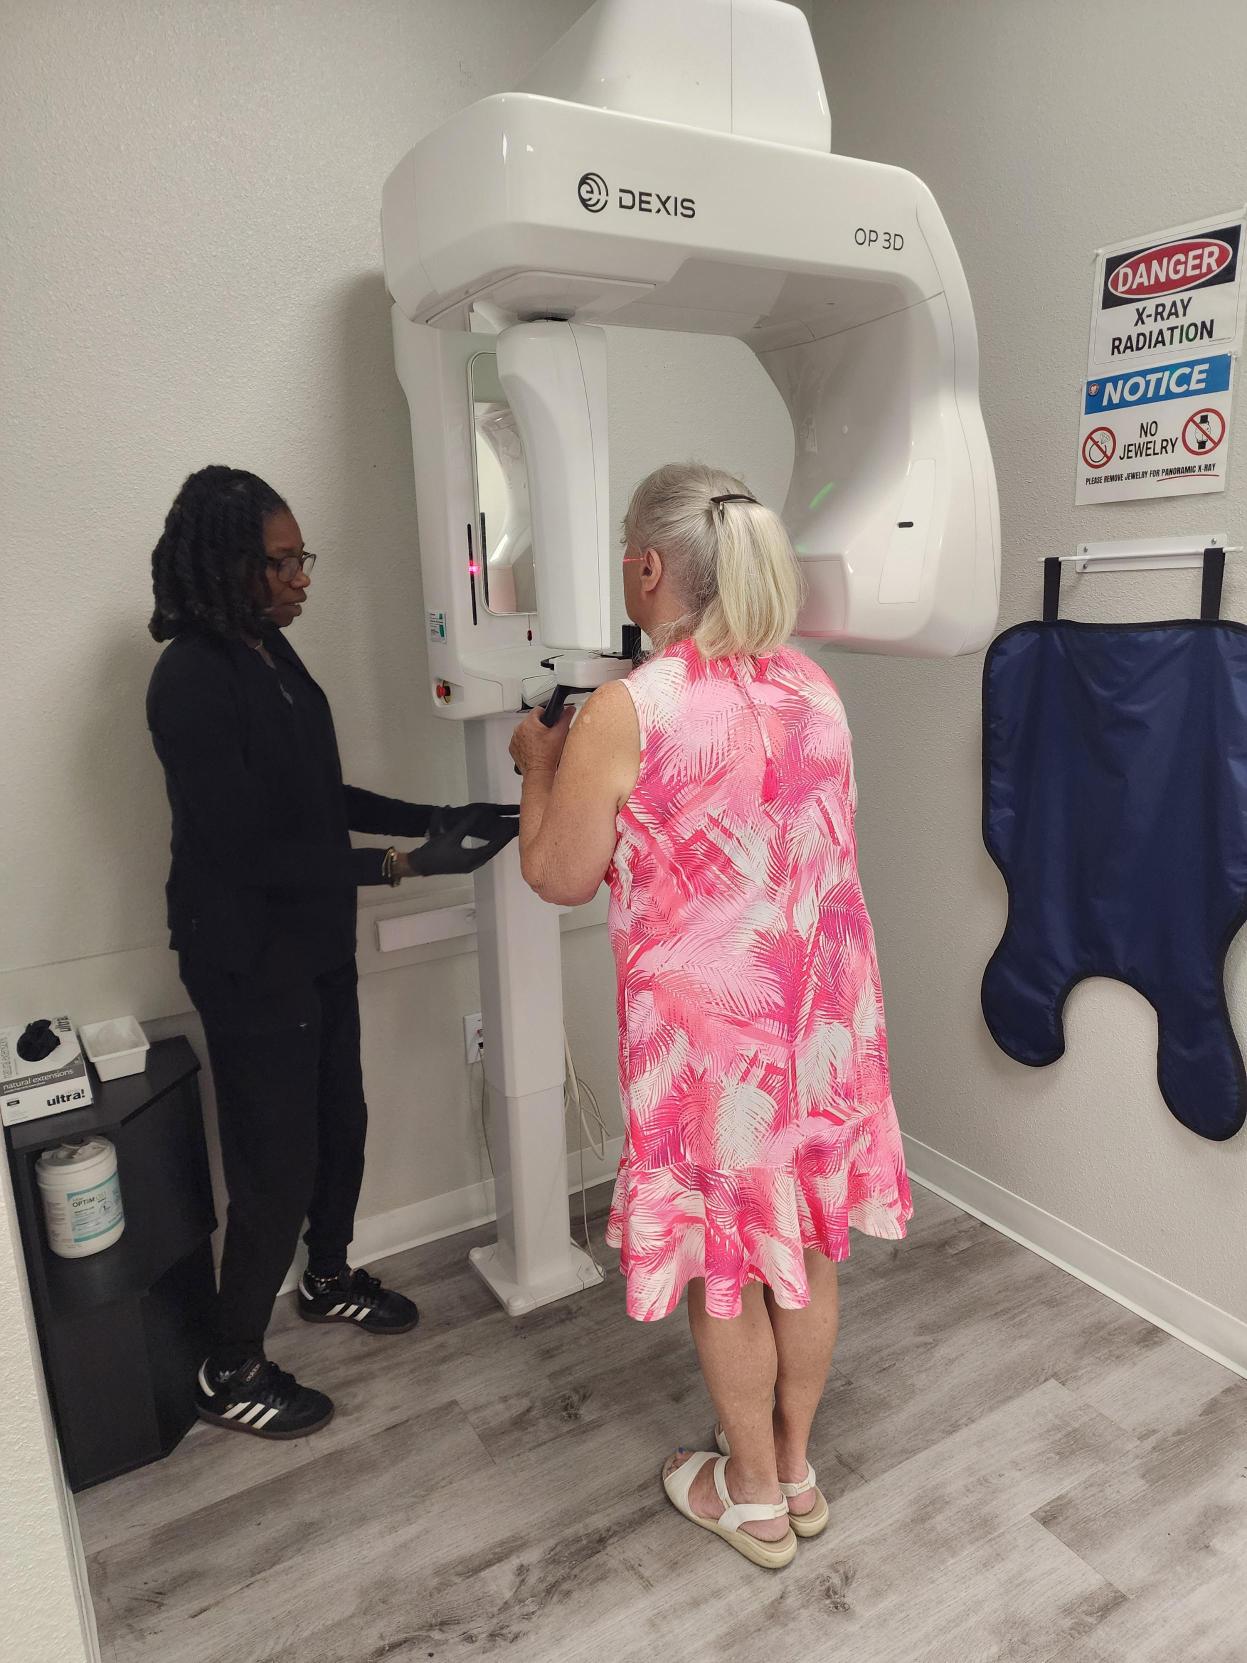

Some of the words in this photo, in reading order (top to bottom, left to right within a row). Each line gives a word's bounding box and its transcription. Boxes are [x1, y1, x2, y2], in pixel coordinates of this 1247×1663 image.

[618, 188, 696, 219] DEXIS
[854, 227, 879, 248] OP
[882, 232, 905, 251] 3D
[1116, 245, 1220, 293] DANGER
[1133, 297, 1193, 327] X-RAY
[1110, 319, 1215, 356] RADIATION
[1101, 363, 1210, 407] NOTICE
[1139, 420, 1158, 439] NO
[1118, 437, 1178, 461] JEWELRY
[1085, 476, 1103, 486] PLEASE
[1103, 473, 1124, 484] REMOVE
[1124, 470, 1149, 481] JEWELRY
[1149, 469, 1161, 478] FOR
[1161, 465, 1197, 477] PANORAMIC
[1197, 463, 1217, 473] X-RAY
[2, 1078, 32, 1091] natural
[32, 1068, 74, 1083] extensions
[46, 1089, 86, 1107] ultra!
